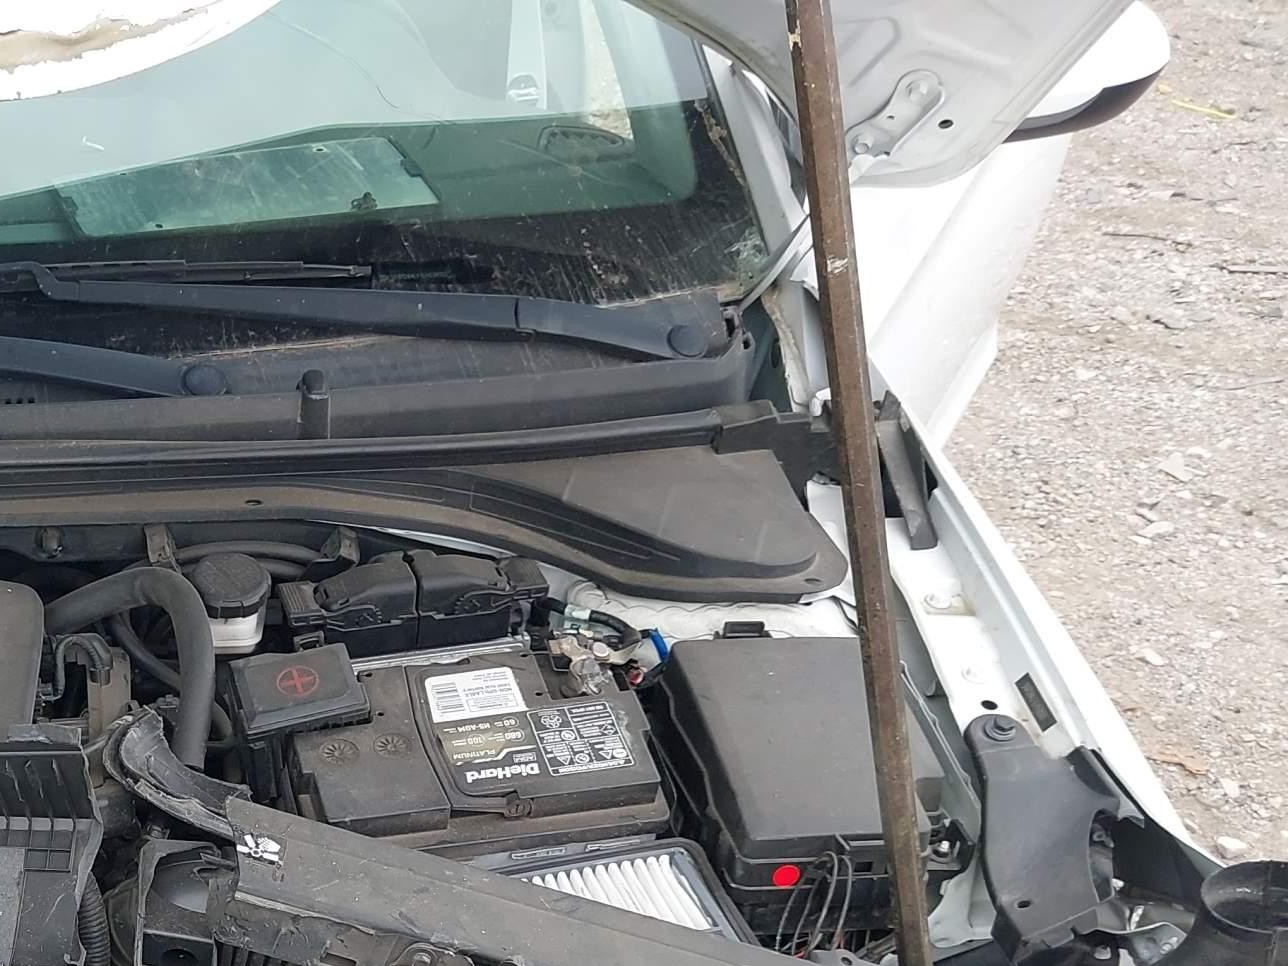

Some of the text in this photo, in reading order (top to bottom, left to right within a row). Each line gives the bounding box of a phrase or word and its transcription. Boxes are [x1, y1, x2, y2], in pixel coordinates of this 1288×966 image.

[505, 731, 522, 740] 680
[452, 748, 496, 760] PLATINUM
[464, 762, 540, 784] DieHard
